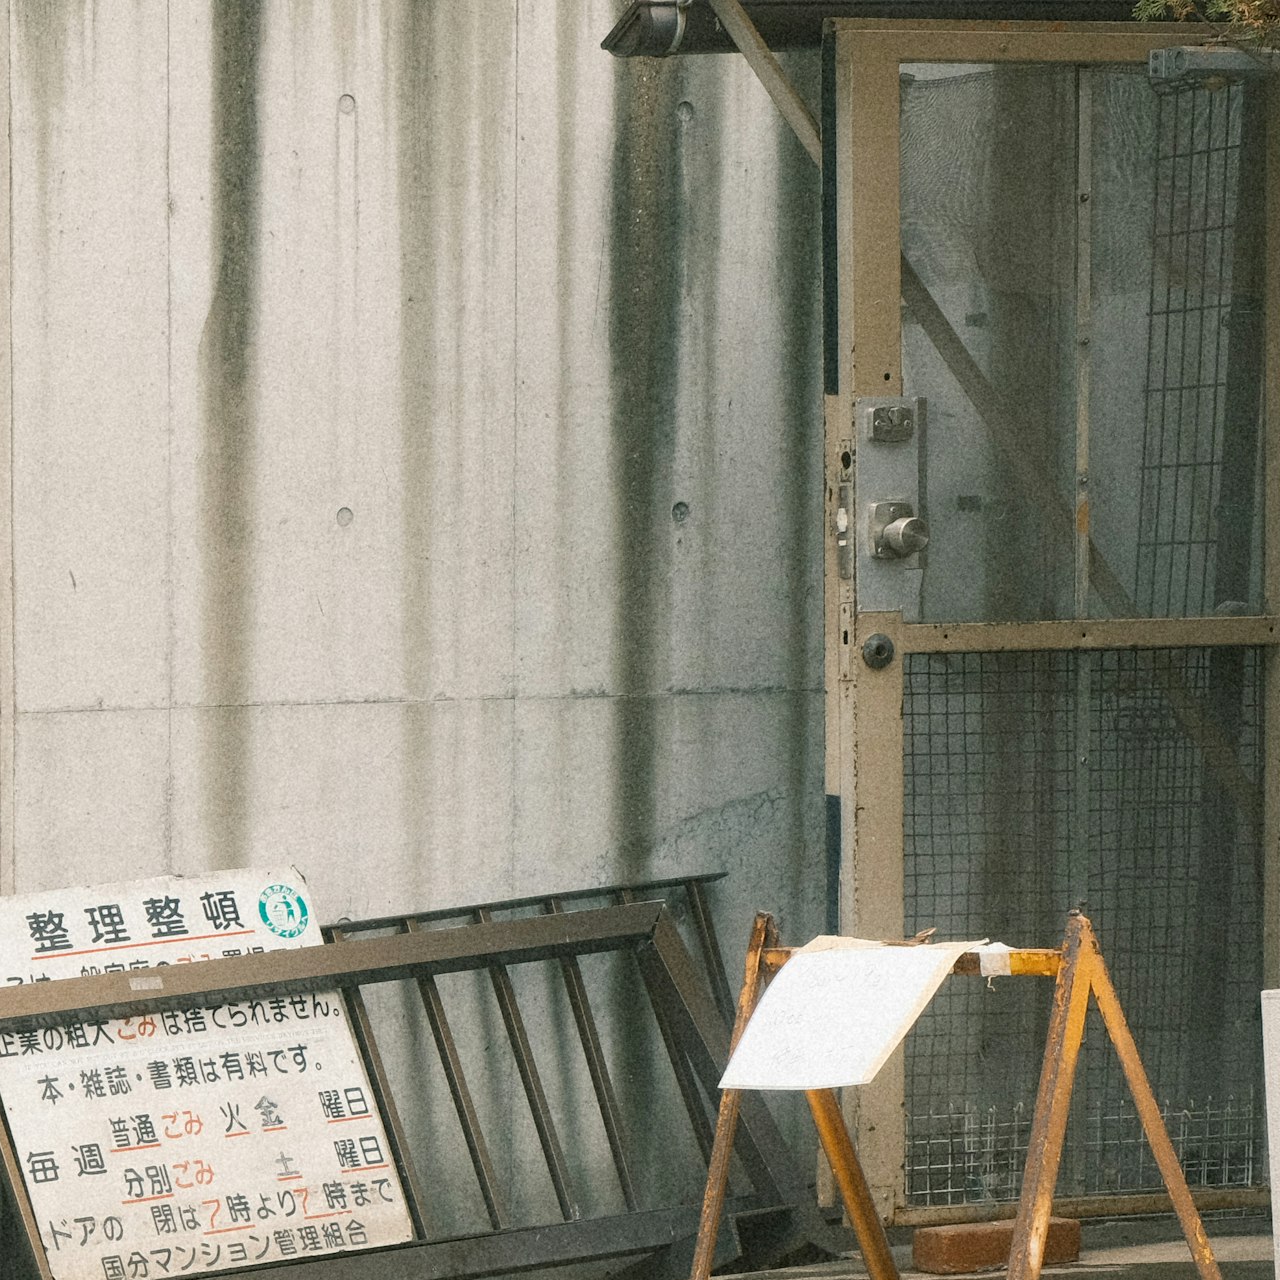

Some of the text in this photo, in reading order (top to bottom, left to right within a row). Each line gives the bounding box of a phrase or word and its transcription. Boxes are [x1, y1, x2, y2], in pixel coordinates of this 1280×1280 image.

[26, 891, 245, 953] 整理整頓
[37, 1044, 322, 1105] 本・雑誌・書類は有料です。
[318, 1087, 370, 1119] 曜日
[274, 1151, 301, 1177] 土
[333, 1136, 384, 1168] 曜日
